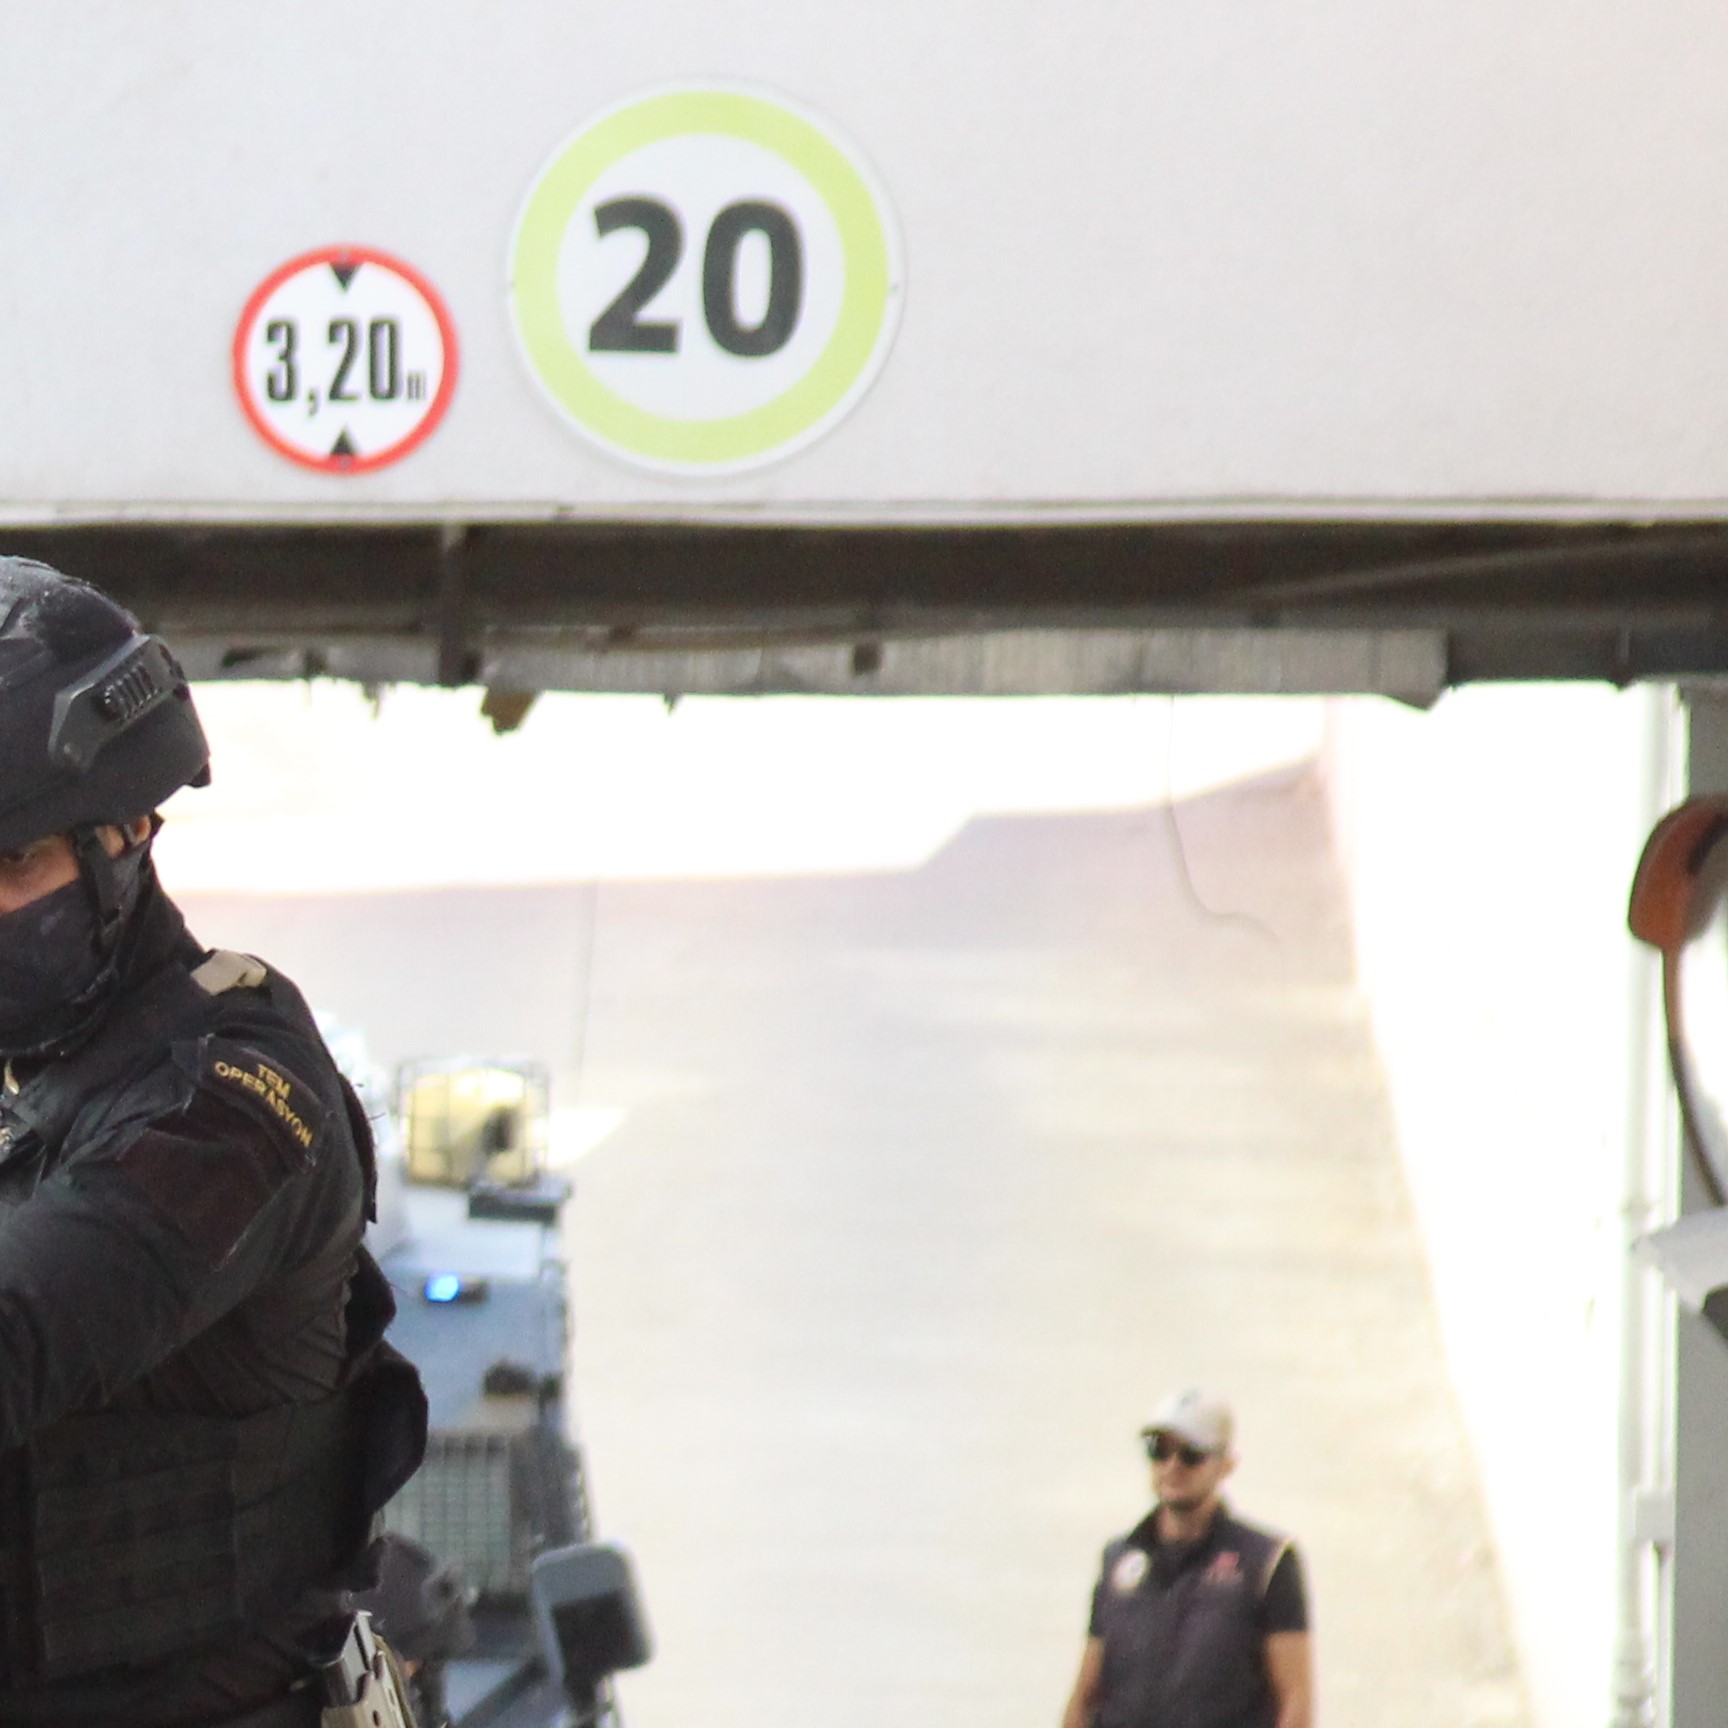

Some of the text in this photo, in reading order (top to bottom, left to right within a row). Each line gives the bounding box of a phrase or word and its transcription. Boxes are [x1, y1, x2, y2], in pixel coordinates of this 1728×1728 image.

[588, 196, 804, 358] 20
[213, 1060, 314, 1148] OPERASYON
[256, 1062, 293, 1101] TEM
